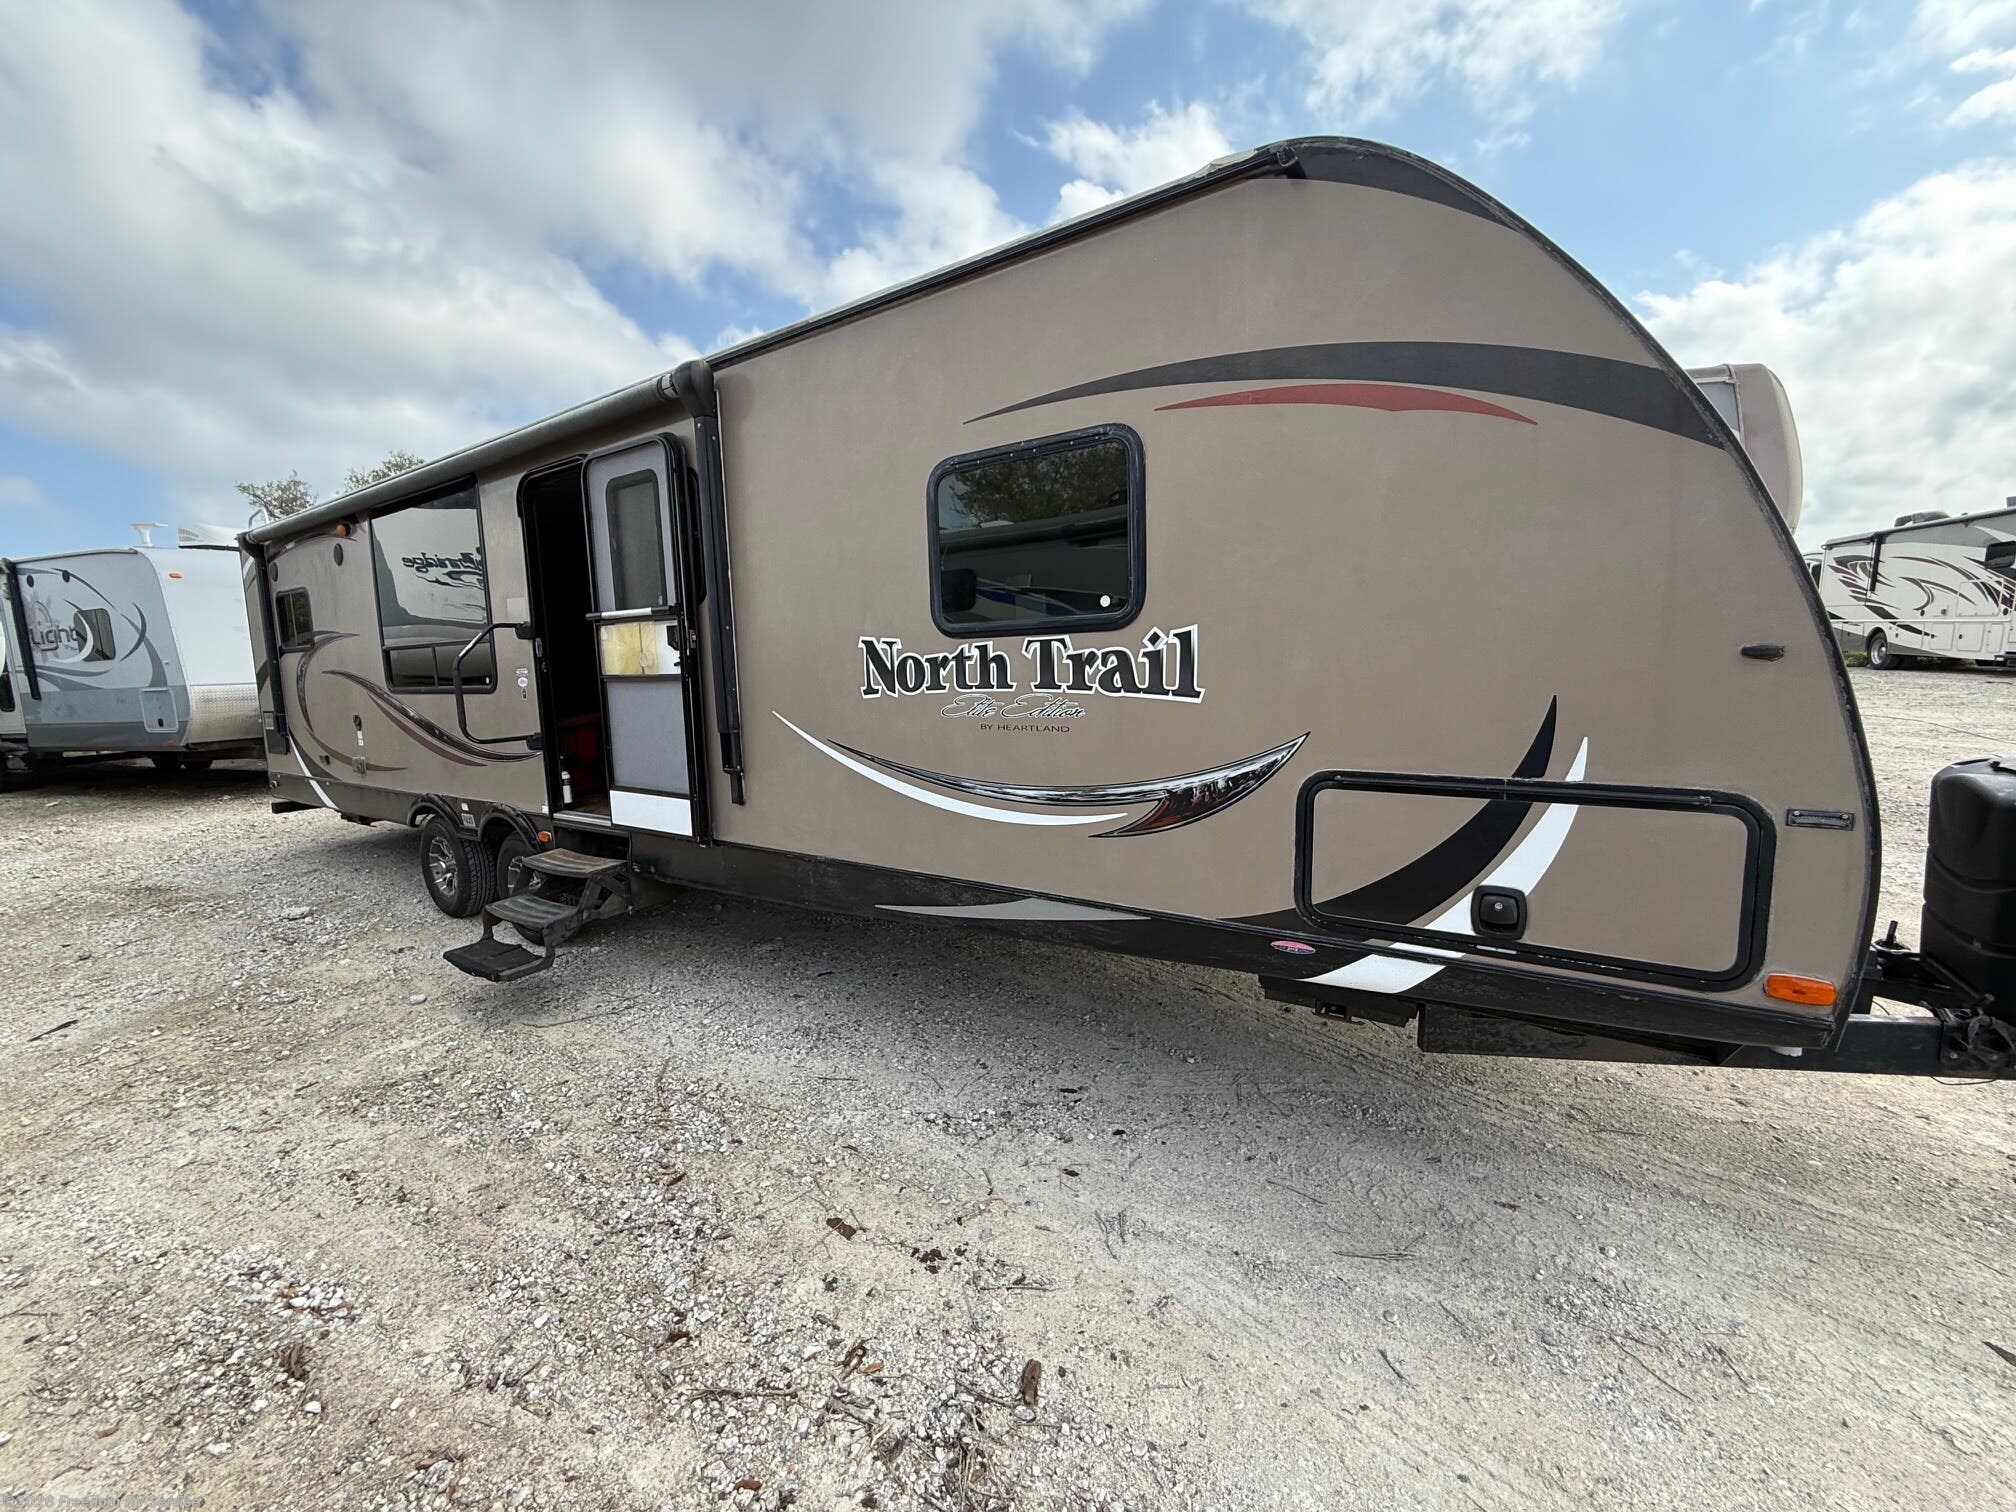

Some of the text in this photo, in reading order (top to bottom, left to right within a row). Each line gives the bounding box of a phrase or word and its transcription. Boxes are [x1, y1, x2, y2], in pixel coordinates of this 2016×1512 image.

[858, 623, 1206, 704] North Trail
[940, 693, 1087, 719] Elite Edition
[980, 723, 1071, 733] BY HEARTLAND
